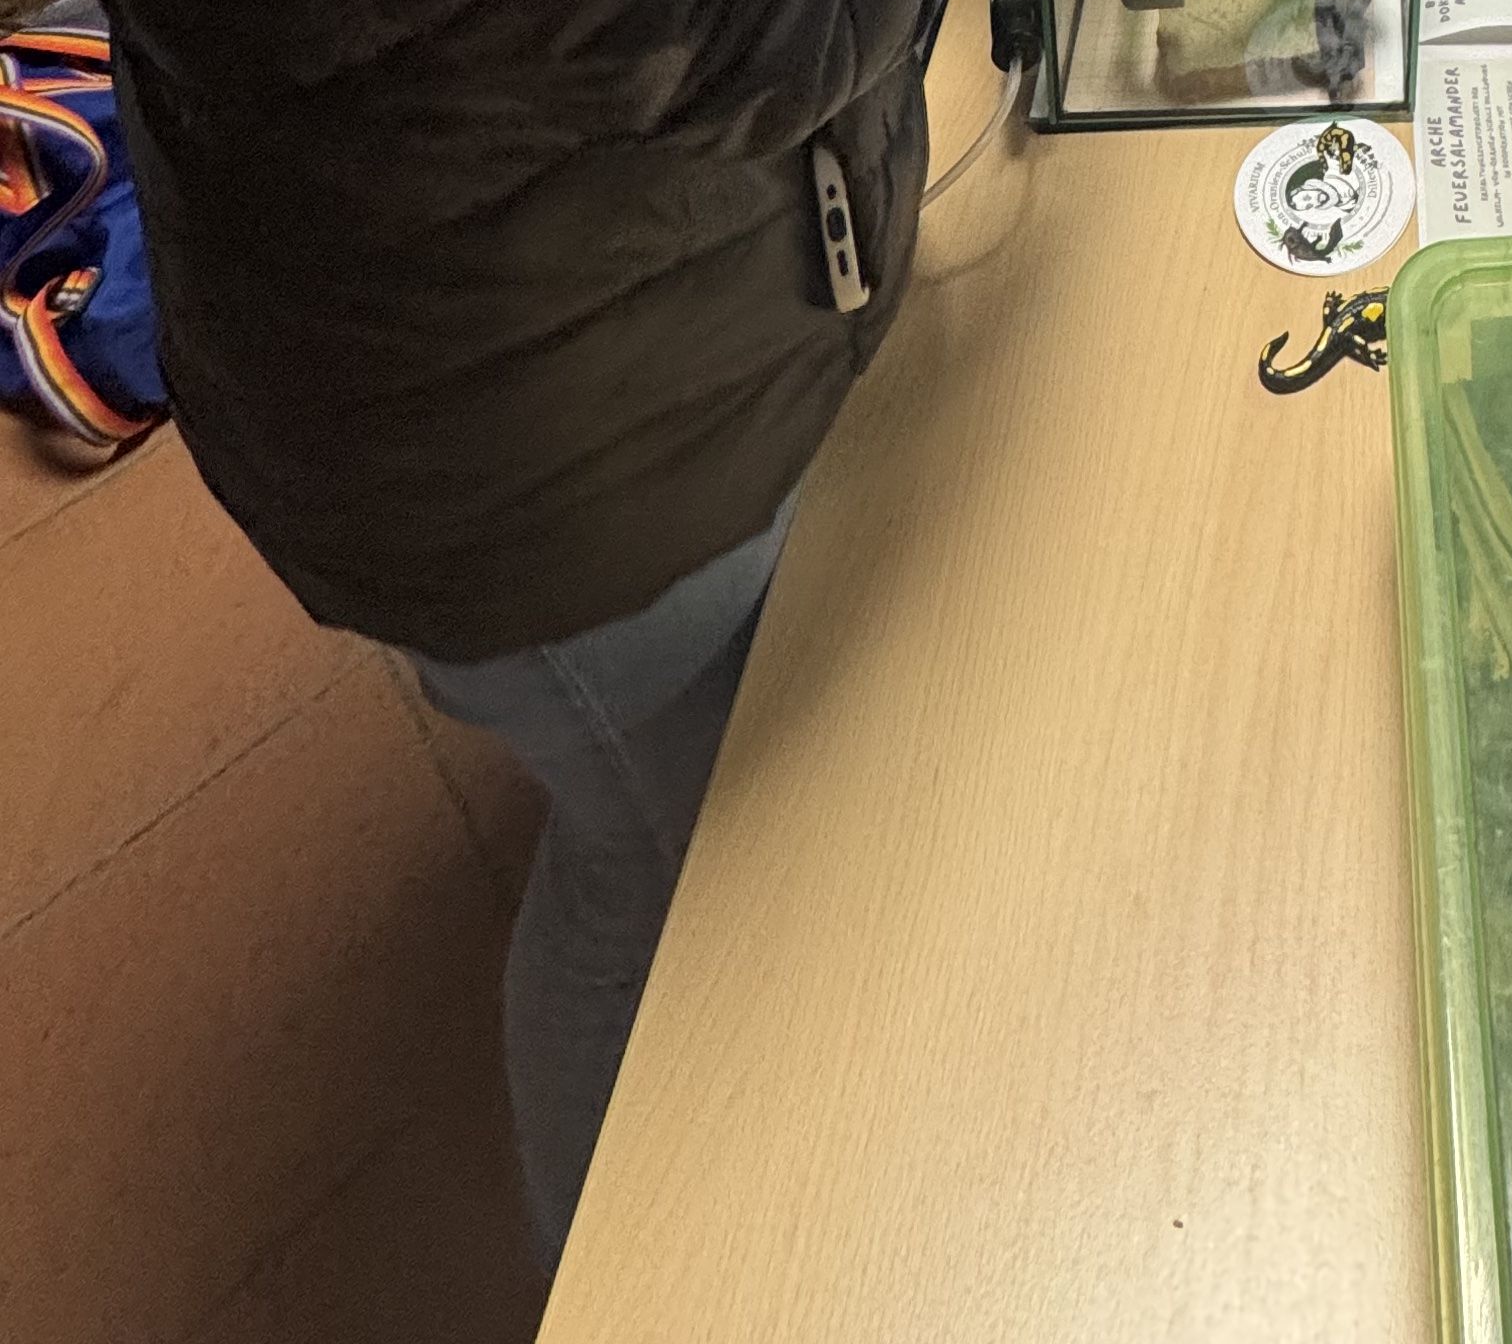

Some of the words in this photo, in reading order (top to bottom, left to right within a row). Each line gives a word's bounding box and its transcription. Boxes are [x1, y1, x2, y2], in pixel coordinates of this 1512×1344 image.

[1427, 116, 1446, 167] ARCHE
[1444, 66, 1472, 224] FEUERSALAMANDER
[1248, 161, 1265, 213] VIVARIUM
